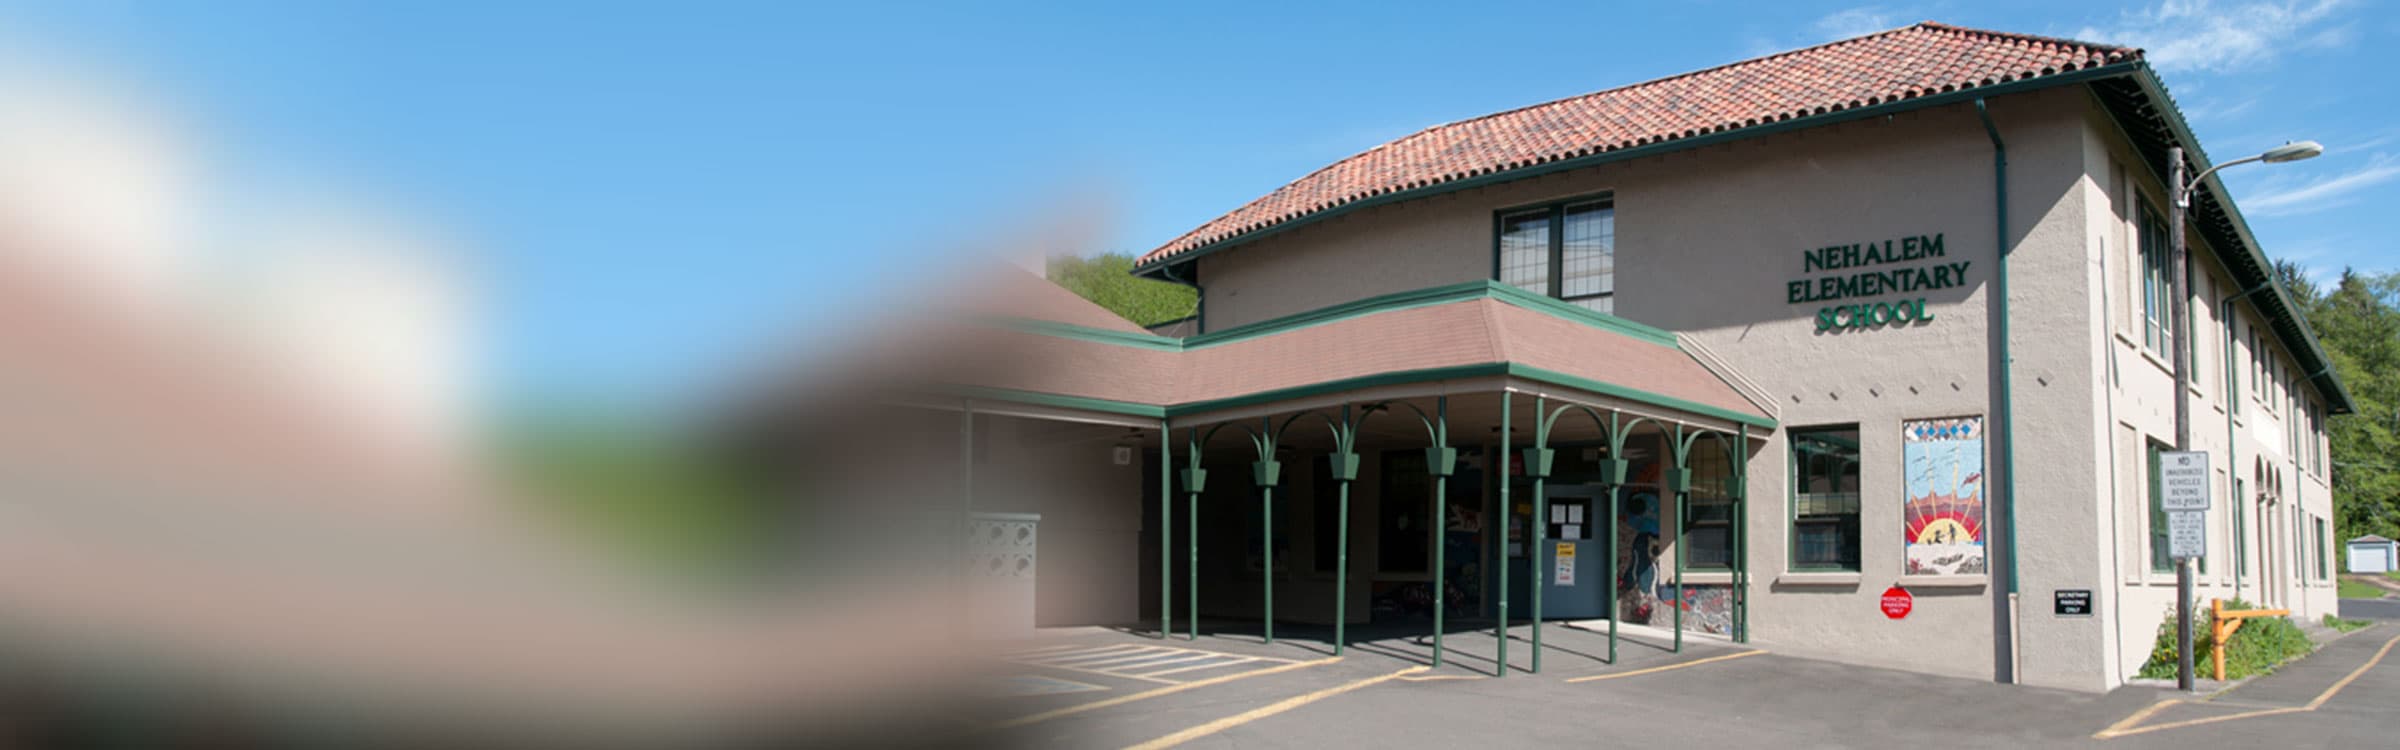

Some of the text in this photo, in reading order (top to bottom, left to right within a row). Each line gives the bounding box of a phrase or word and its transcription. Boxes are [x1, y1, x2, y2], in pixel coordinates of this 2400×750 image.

[1804, 233, 1945, 273] NEHALEM
[1787, 261, 1971, 304] ELEMENTARY
[1815, 297, 1936, 332] SCHOOL
[2177, 456, 2191, 466] NO
[2171, 488, 2199, 496] BEYOND
